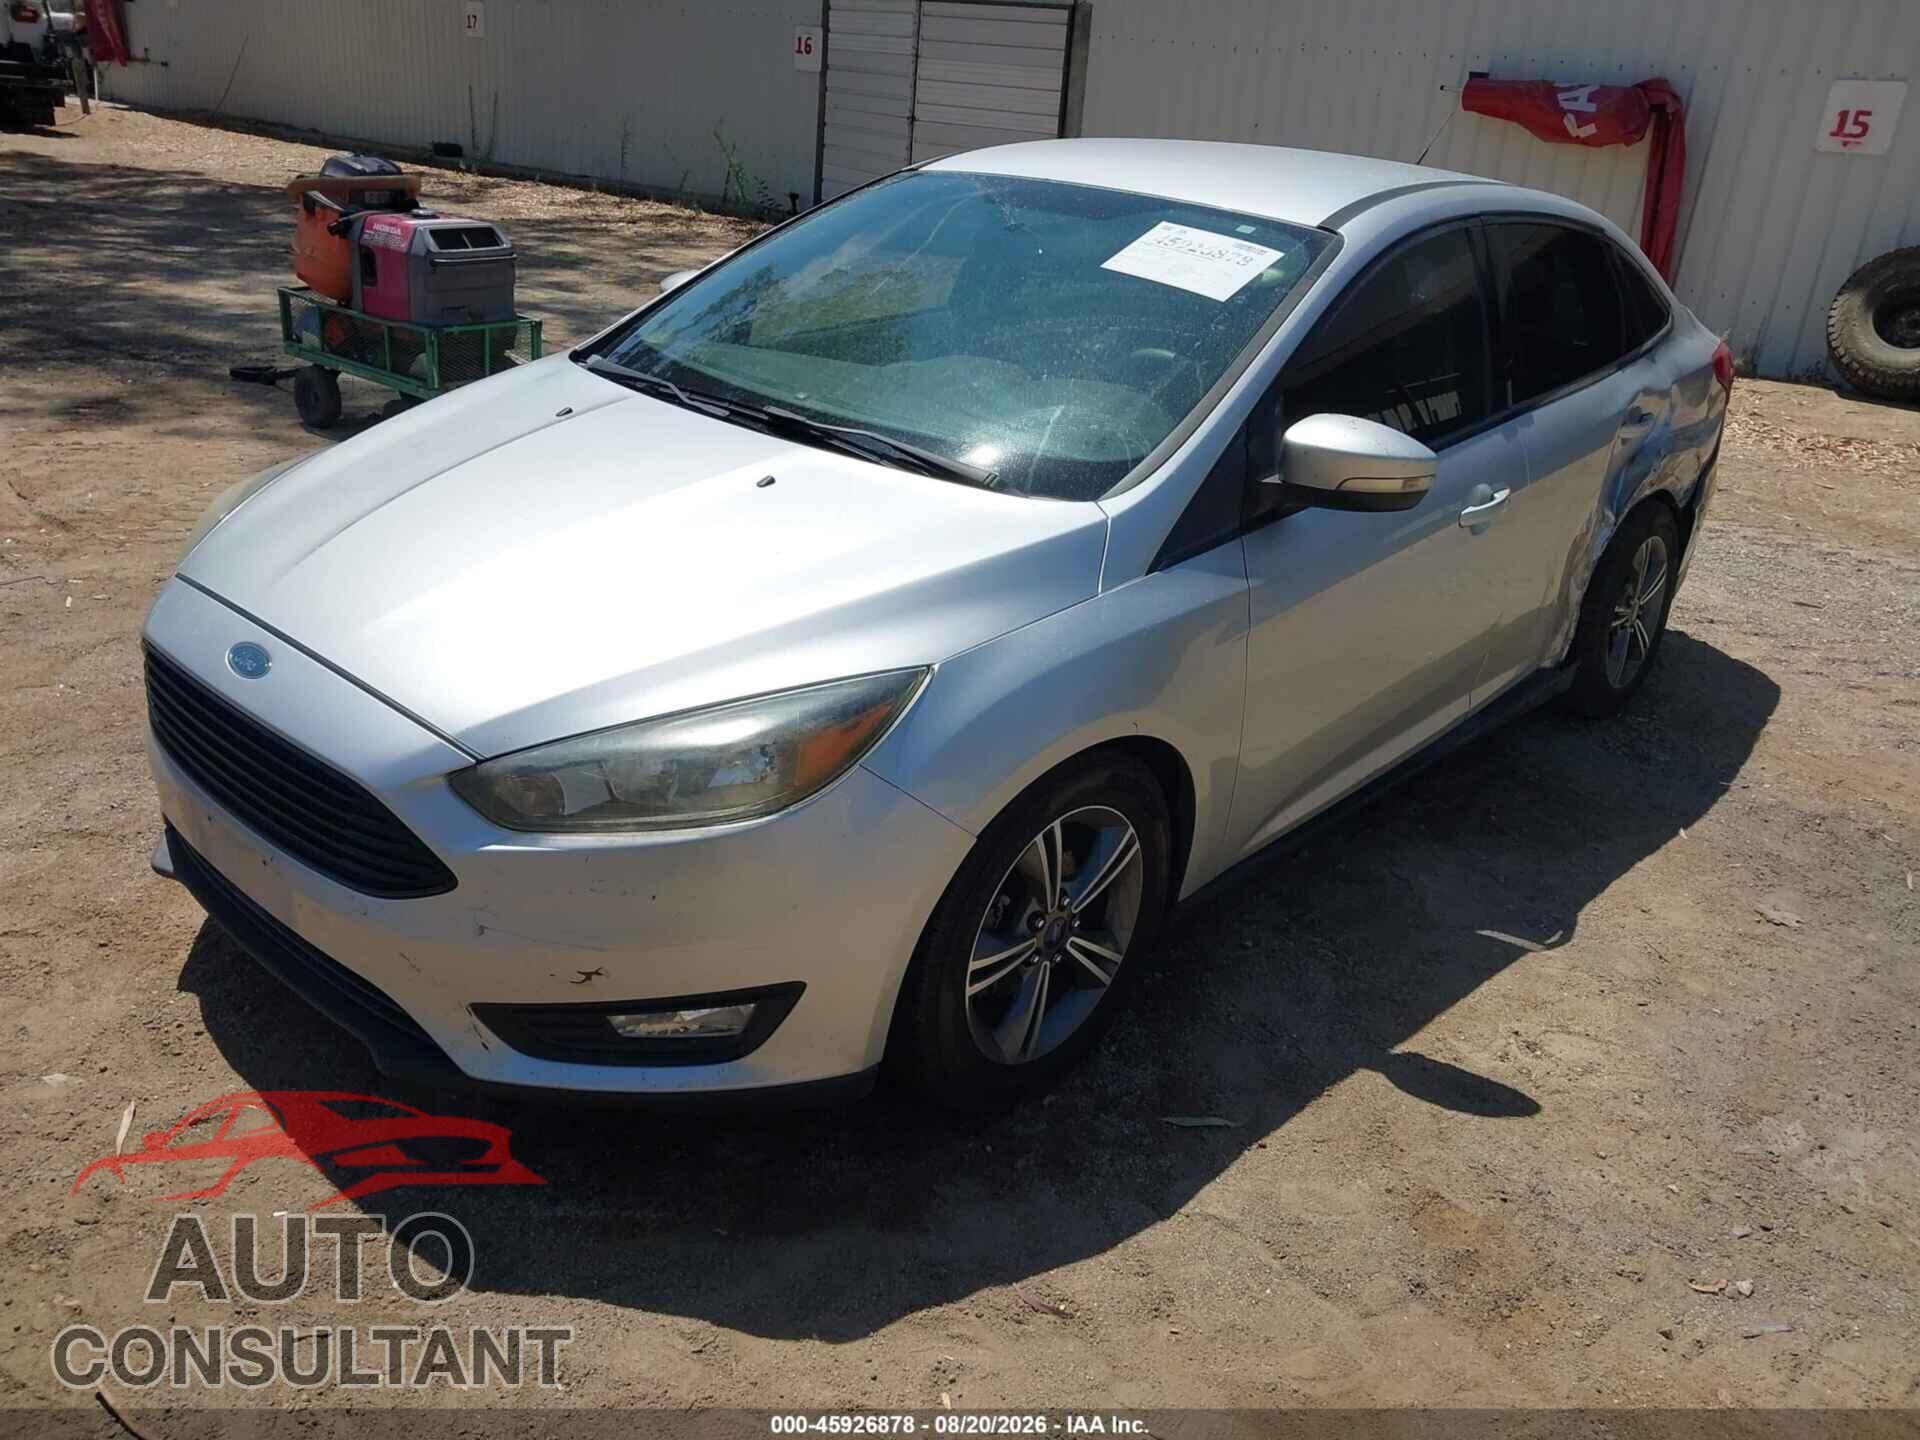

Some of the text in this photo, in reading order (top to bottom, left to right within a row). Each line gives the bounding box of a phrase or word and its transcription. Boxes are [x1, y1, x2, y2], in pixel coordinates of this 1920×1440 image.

[467, 14, 478, 29] 17
[795, 36, 812, 55] 16
[1829, 109, 1873, 139] 15
